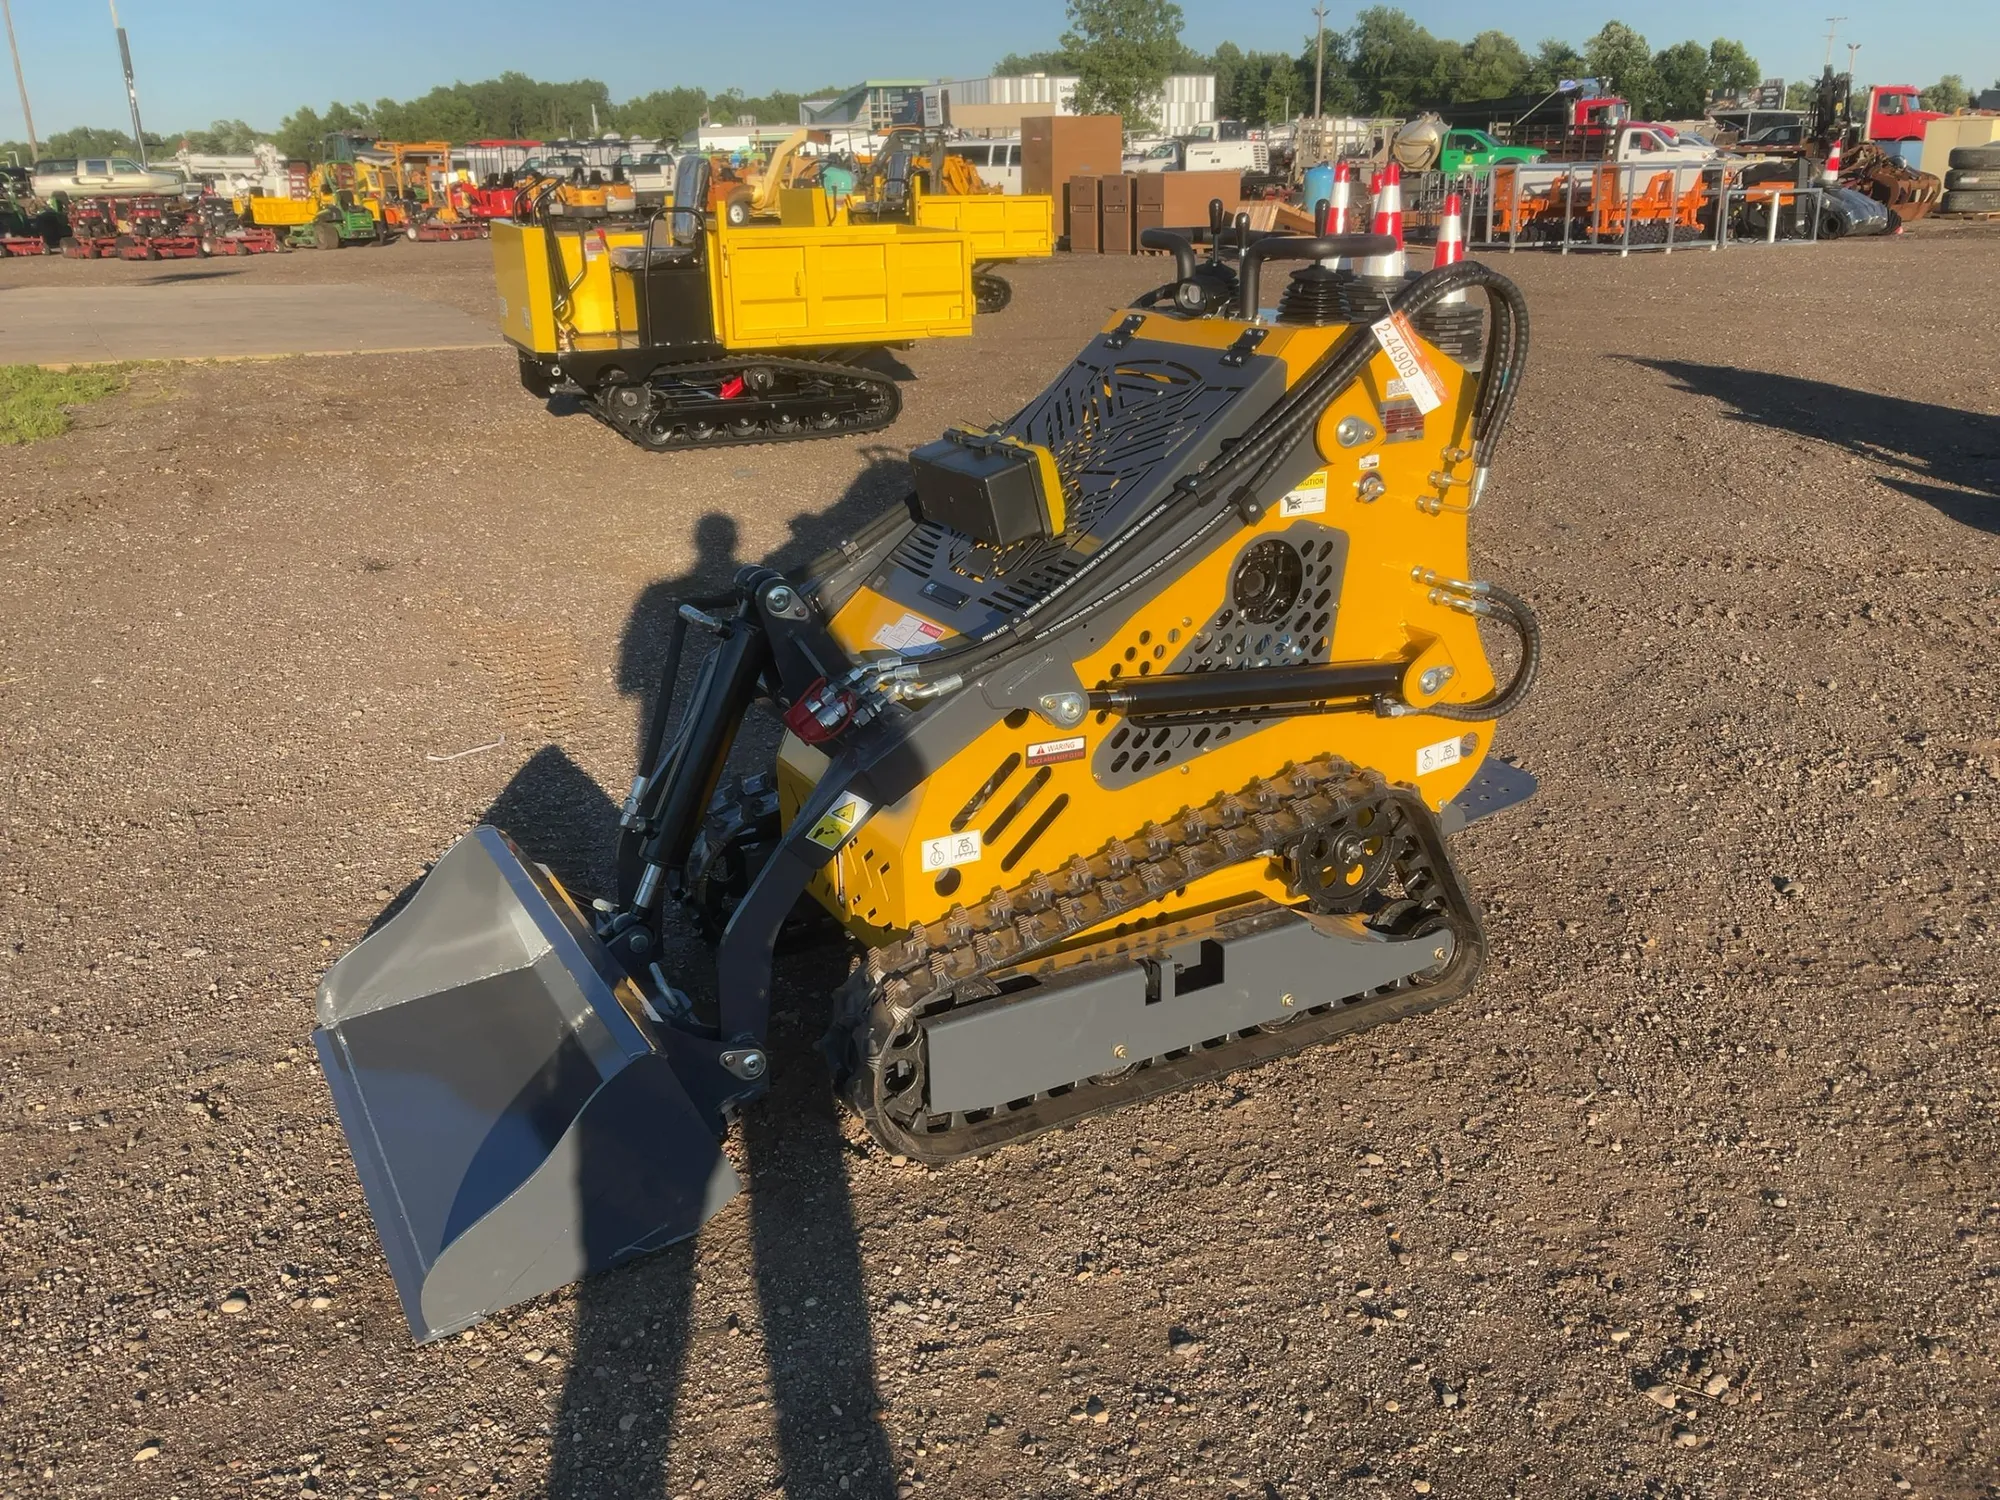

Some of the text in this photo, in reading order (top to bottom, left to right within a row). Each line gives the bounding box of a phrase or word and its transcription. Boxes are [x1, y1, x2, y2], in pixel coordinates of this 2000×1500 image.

[1375, 323, 1420, 379] 2-44909
[1299, 478, 1325, 488] AUTION
[1047, 741, 1075, 752] WARING
